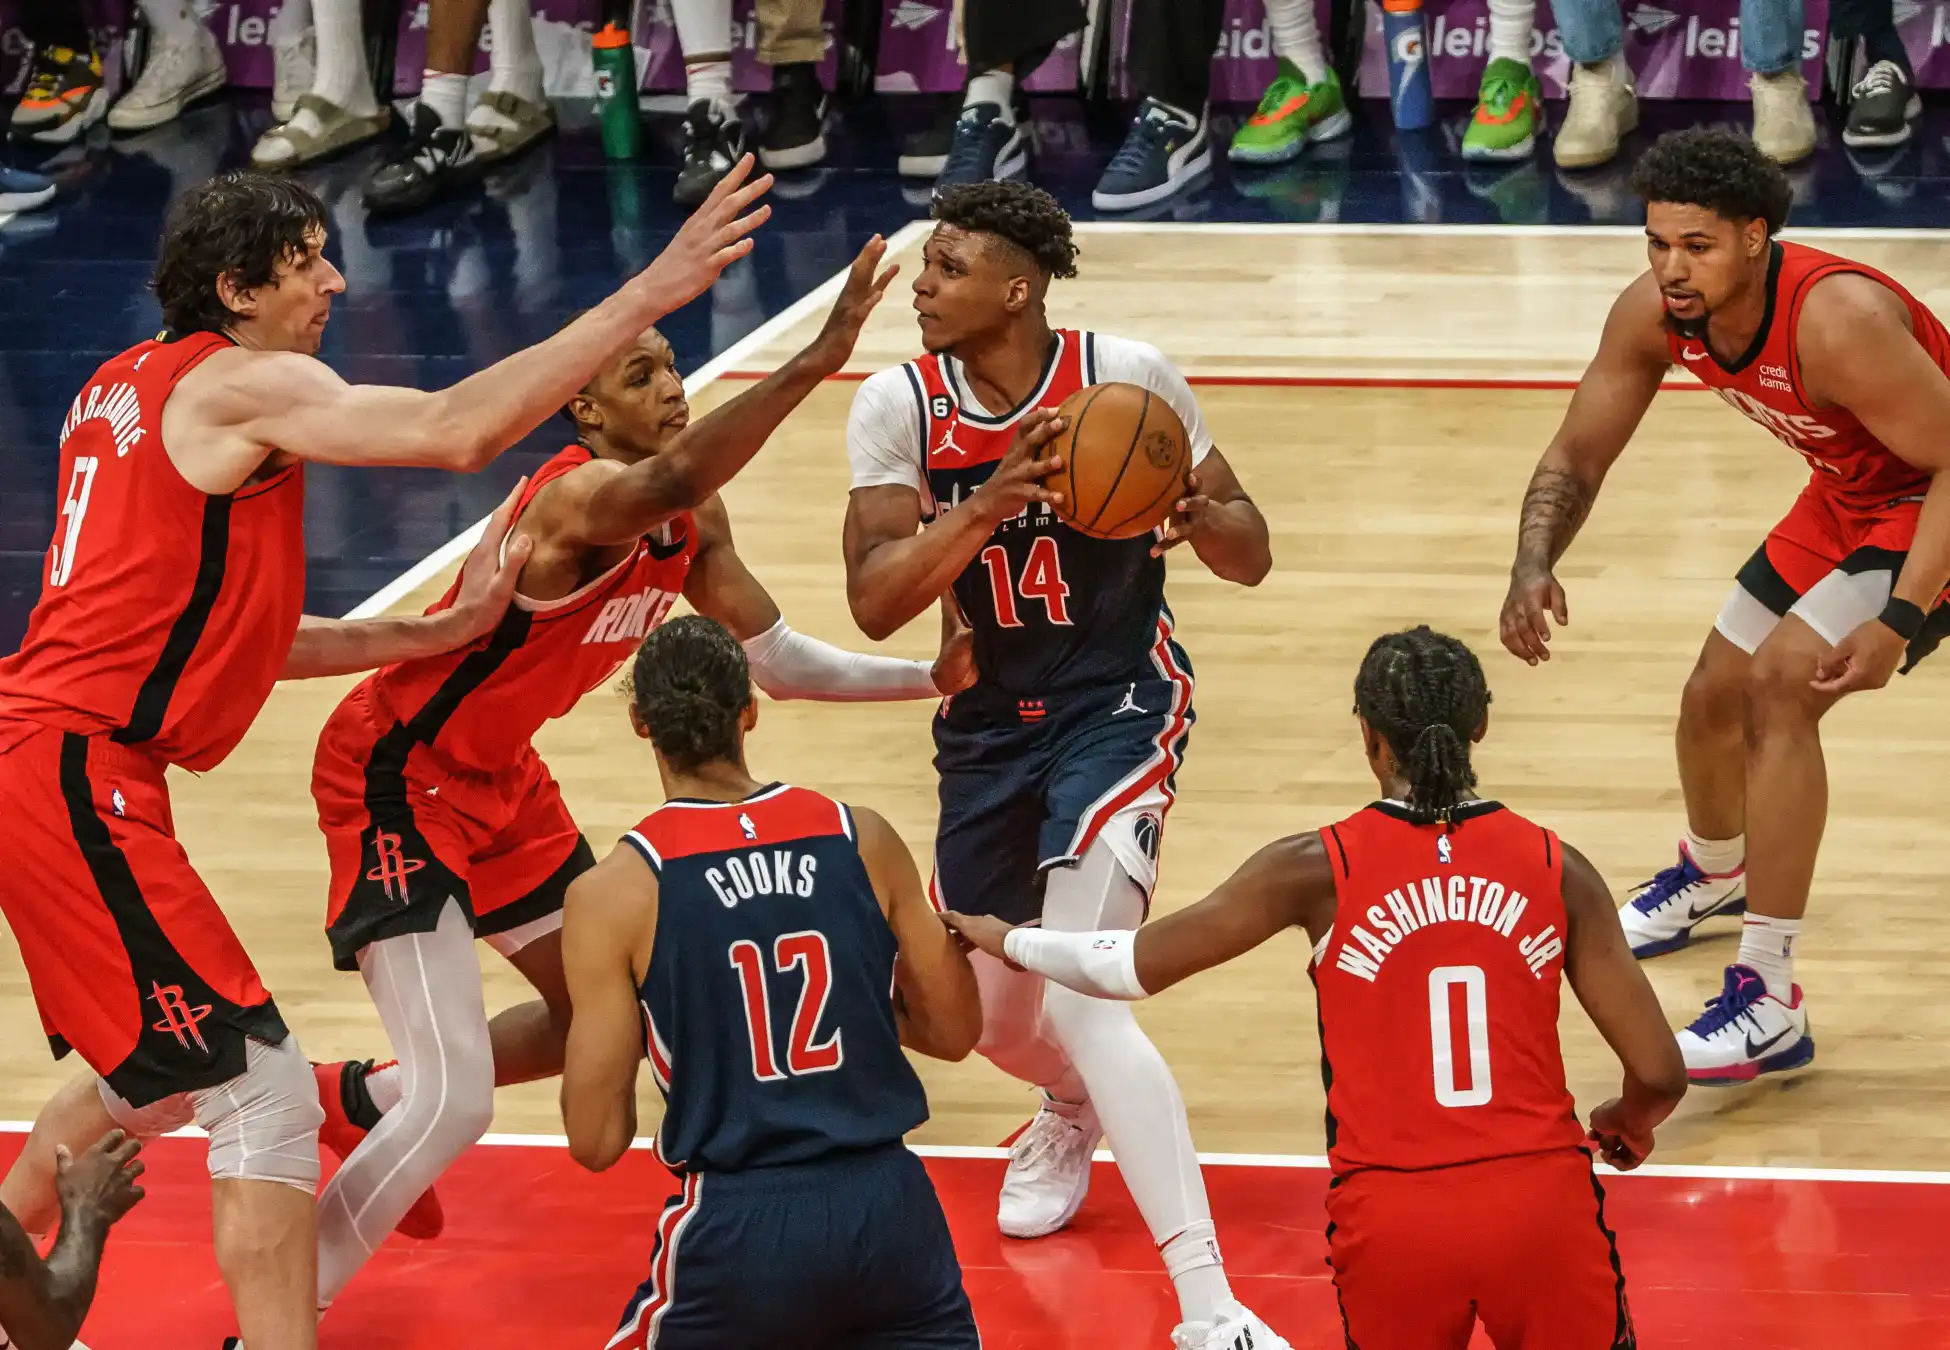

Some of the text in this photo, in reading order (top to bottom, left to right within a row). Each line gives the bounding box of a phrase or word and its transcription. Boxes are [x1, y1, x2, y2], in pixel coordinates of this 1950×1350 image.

[1685, 15, 1820, 58] leis
[1759, 364, 1788, 380] credit
[1759, 374, 1792, 393] karma
[933, 397, 948, 417] 6
[980, 536, 1075, 628] 14
[704, 850, 818, 909] COOKS
[1336, 875, 1529, 983] WASHINGTON
[728, 929, 843, 1082] 12
[1428, 965, 1492, 1108] 0
